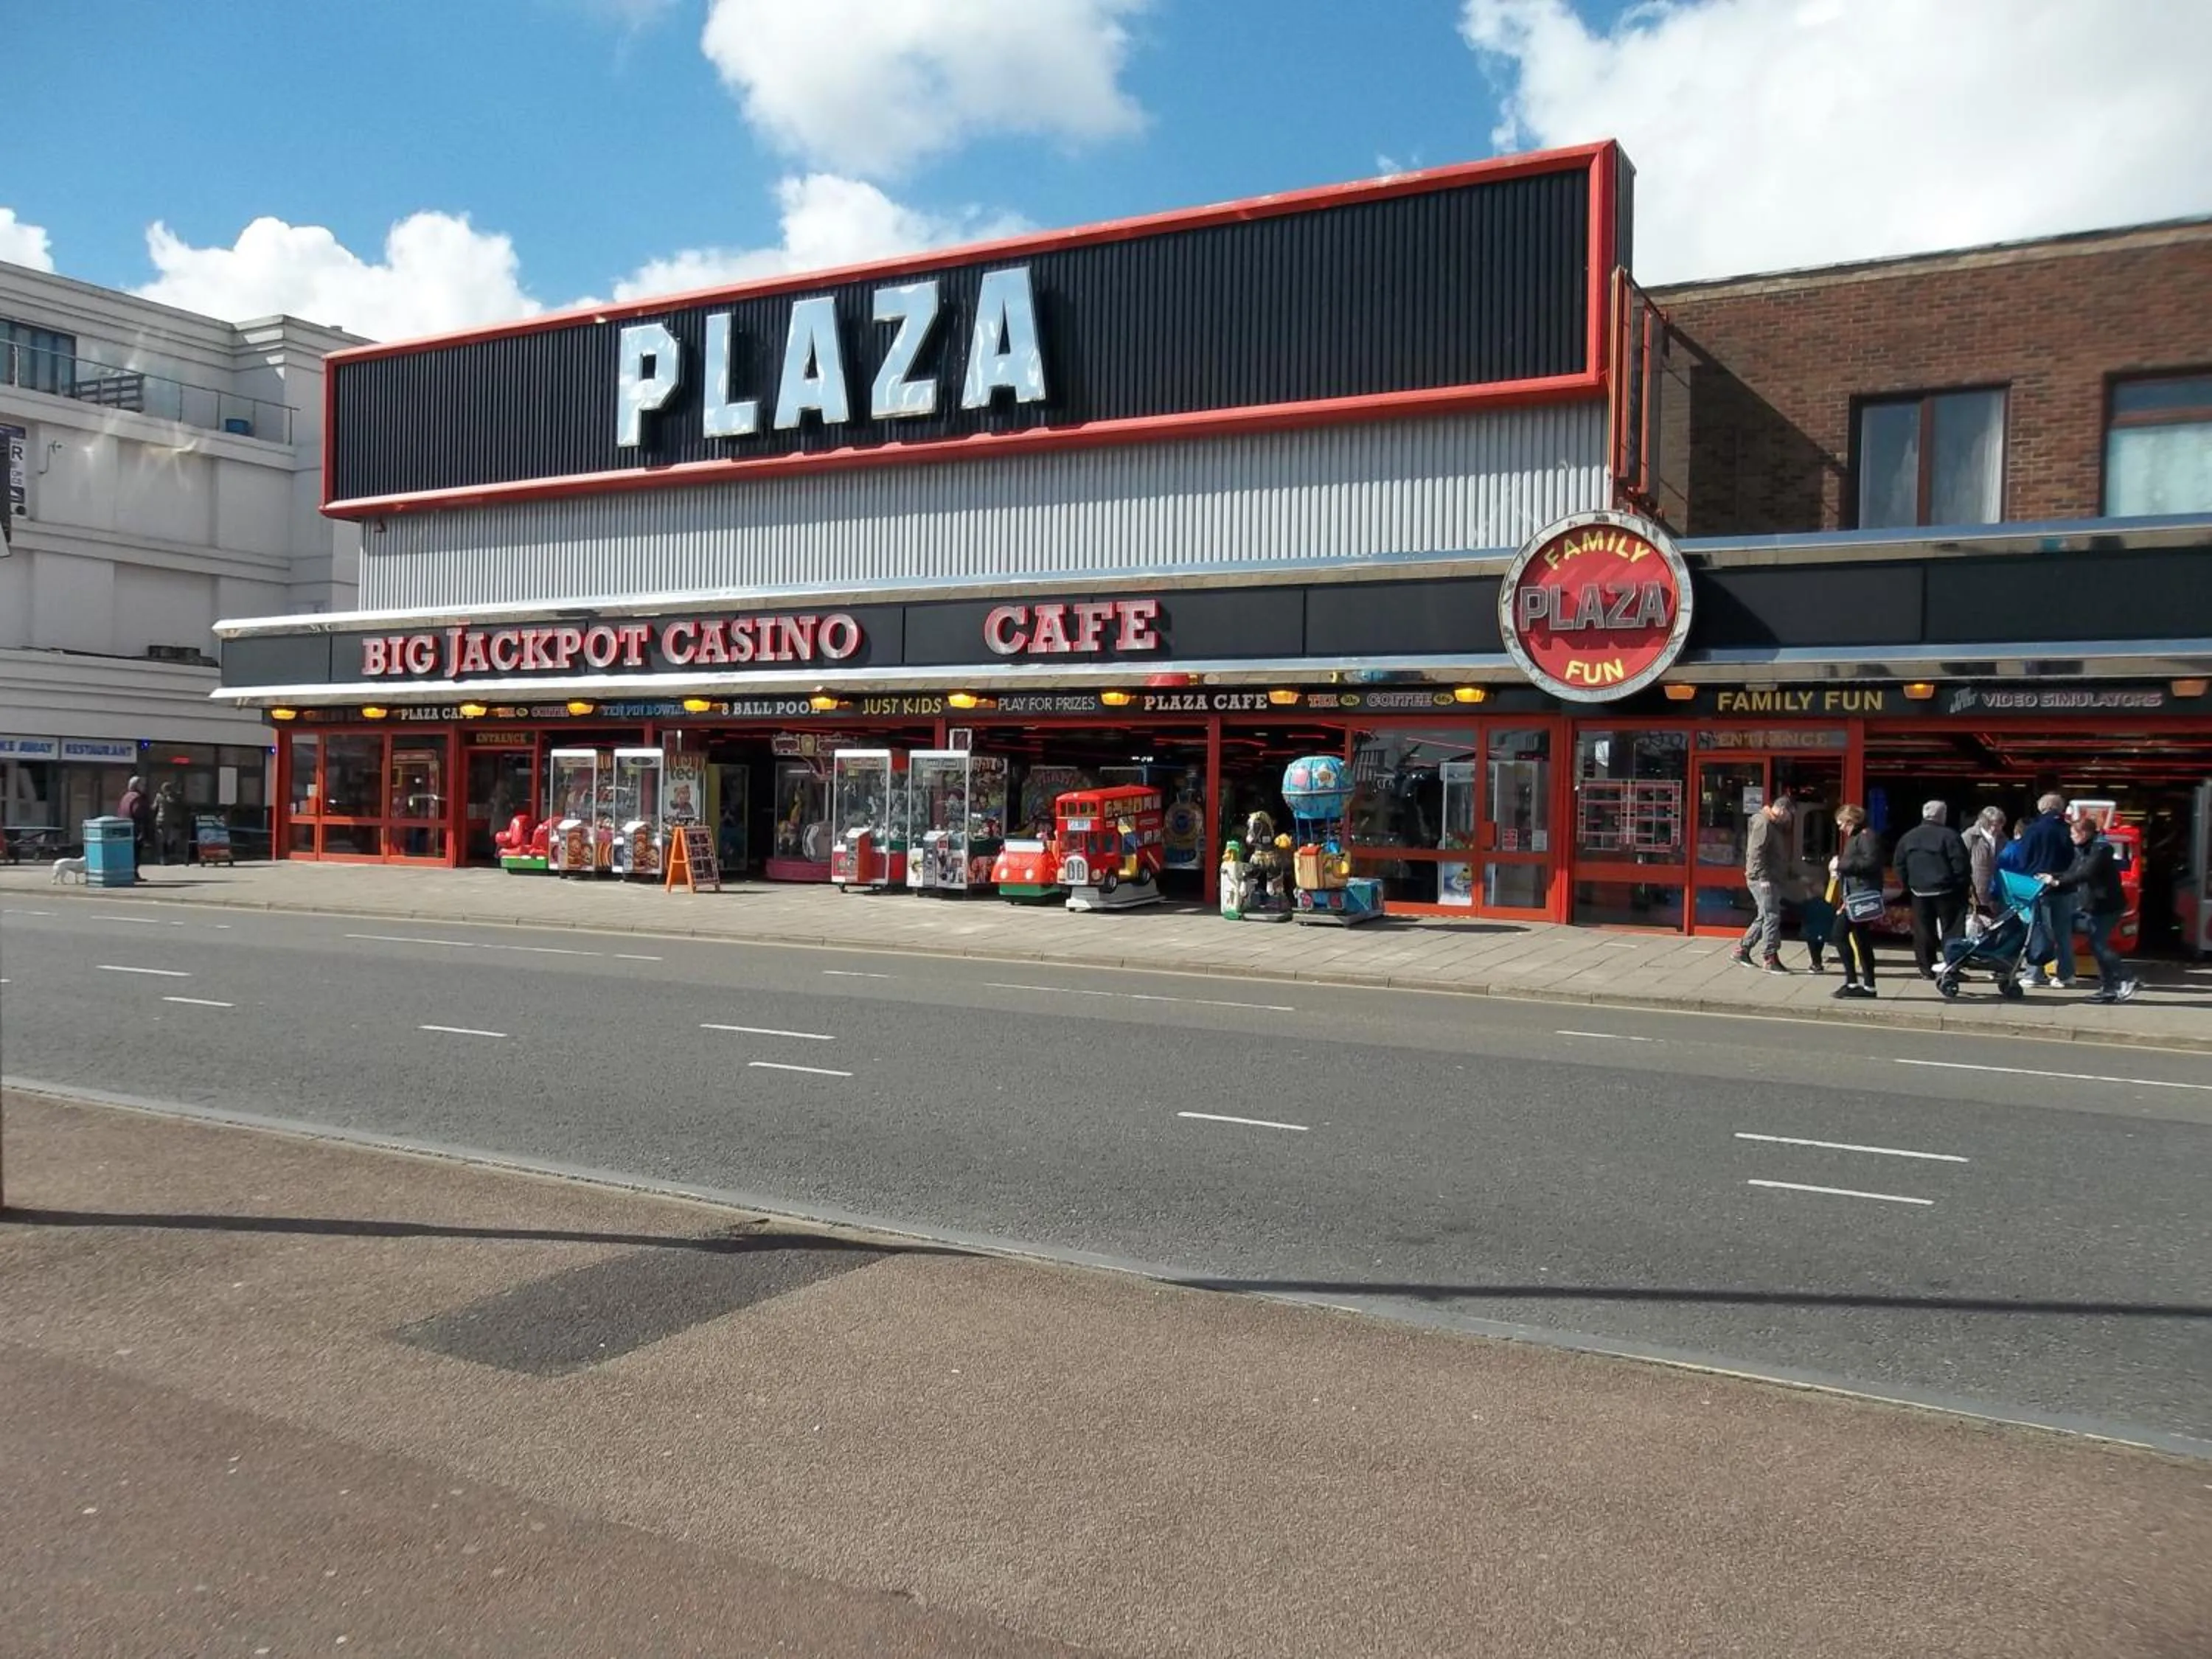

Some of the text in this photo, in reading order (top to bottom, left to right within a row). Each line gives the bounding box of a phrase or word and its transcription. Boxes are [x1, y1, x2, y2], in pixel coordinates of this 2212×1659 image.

[618, 265, 1046, 448] PLAZA
[1544, 530, 1650, 570] FAMILY
[1519, 580, 1667, 633] PLAZA
[984, 599, 1159, 655] CAFE
[362, 613, 863, 680] BIG JACKPOT CASINO
[1565, 658, 1624, 684] FUN
[721, 700, 729, 716] 8
[733, 700, 772, 716] BALL
[862, 698, 942, 715] JUST KIDS
[998, 695, 1096, 712] PLAY FOR PRIZES
[1144, 693, 1268, 711] PLAZA CAFE
[1366, 692, 1433, 707] COFFEE
[1717, 690, 1883, 712] FAMILY FUN
[1981, 692, 2038, 709] VIDEO
[2039, 692, 2163, 709] SIMULATORS
[400, 706, 476, 720] PLAZA CA
